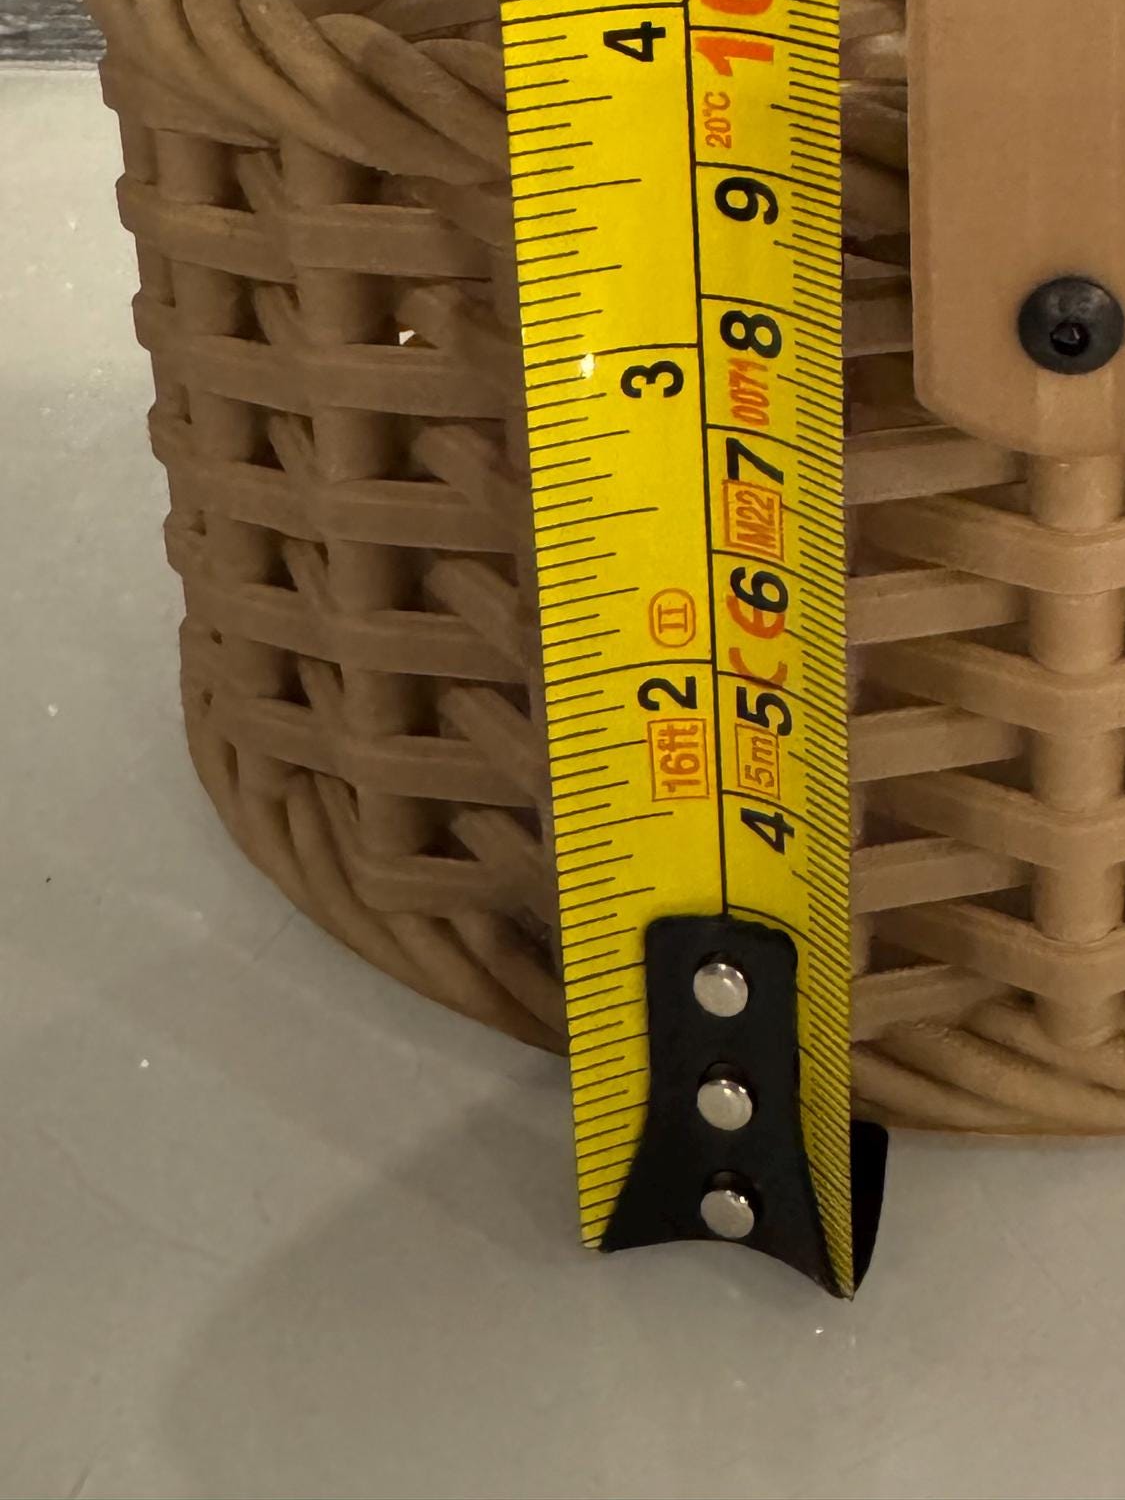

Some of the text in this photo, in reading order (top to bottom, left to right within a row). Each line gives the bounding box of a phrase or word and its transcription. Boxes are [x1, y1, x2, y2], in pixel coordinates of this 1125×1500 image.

[603, 21, 665, 62] 4
[714, 176, 778, 225] 9
[719, 309, 782, 358] 8
[620, 360, 684, 398] 3
[728, 357, 770, 426] 0071
[726, 437, 784, 485] 7
[735, 490, 777, 548] M22
[730, 566, 789, 613] 6
[637, 676, 698, 711] 2
[736, 685, 793, 736] 5
[657, 722, 700, 792] 16ft
[745, 736, 776, 788] 5m
[740, 807, 795, 854] 4
